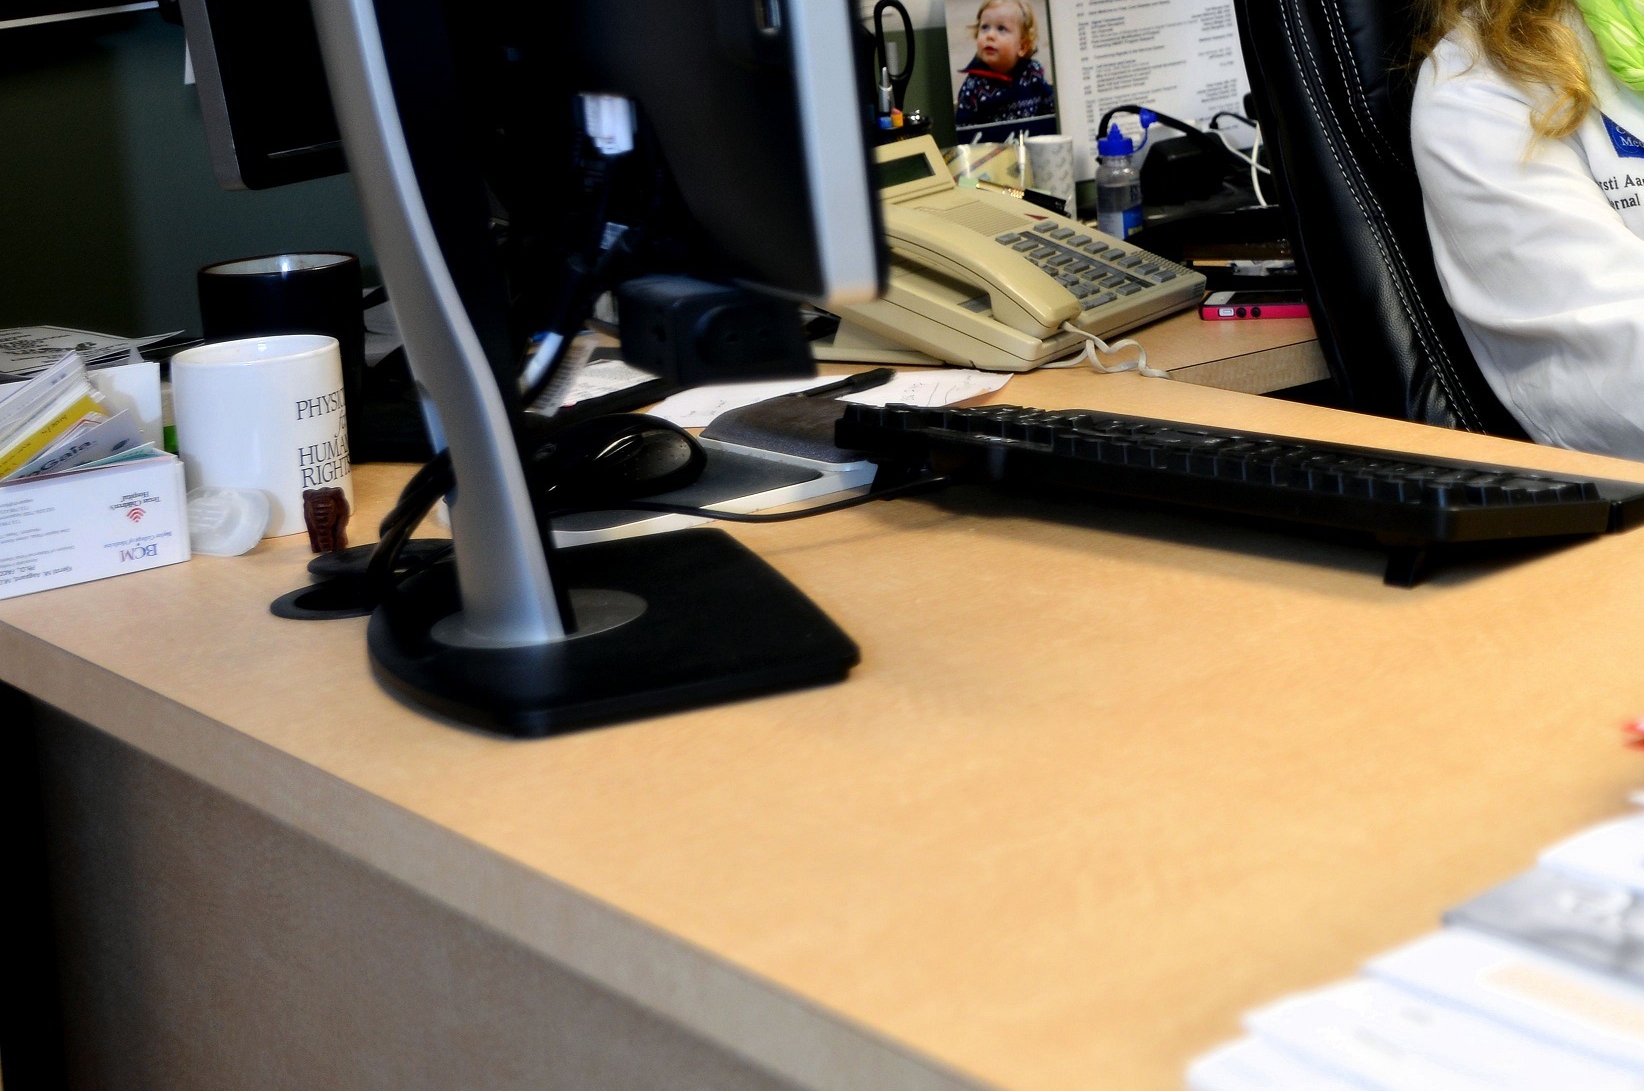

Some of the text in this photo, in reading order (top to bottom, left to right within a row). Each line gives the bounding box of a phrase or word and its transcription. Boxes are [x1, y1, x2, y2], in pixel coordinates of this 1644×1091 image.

[122, 491, 149, 502] Hospital
[144, 496, 160, 505] Texas
[120, 543, 158, 563] BCM
